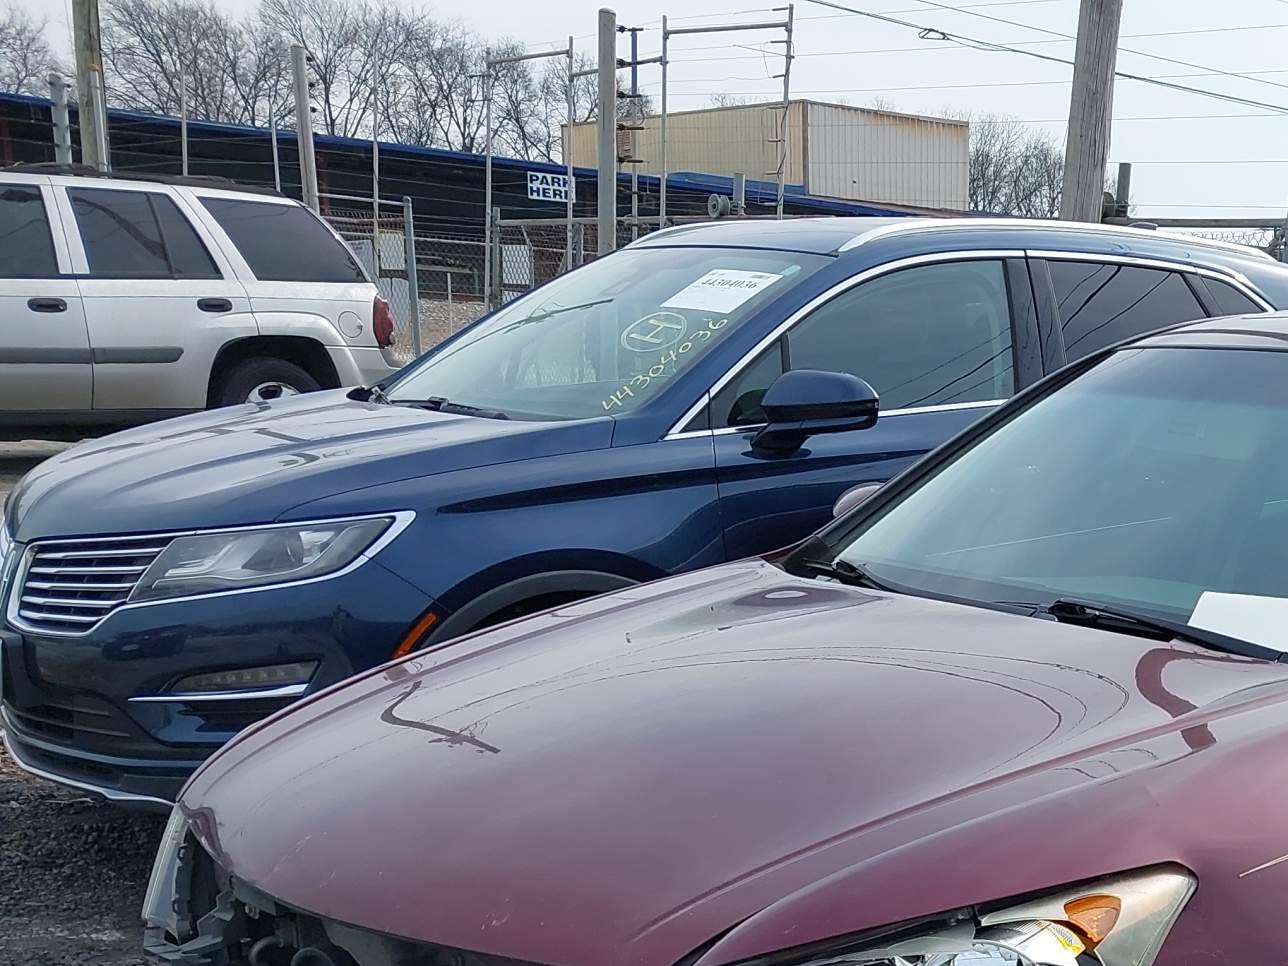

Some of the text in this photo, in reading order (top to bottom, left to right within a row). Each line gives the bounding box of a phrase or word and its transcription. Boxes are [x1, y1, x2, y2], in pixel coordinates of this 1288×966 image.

[529, 174, 569, 188] PARK
[629, 318, 682, 344] H
[602, 318, 728, 411] 44304036
